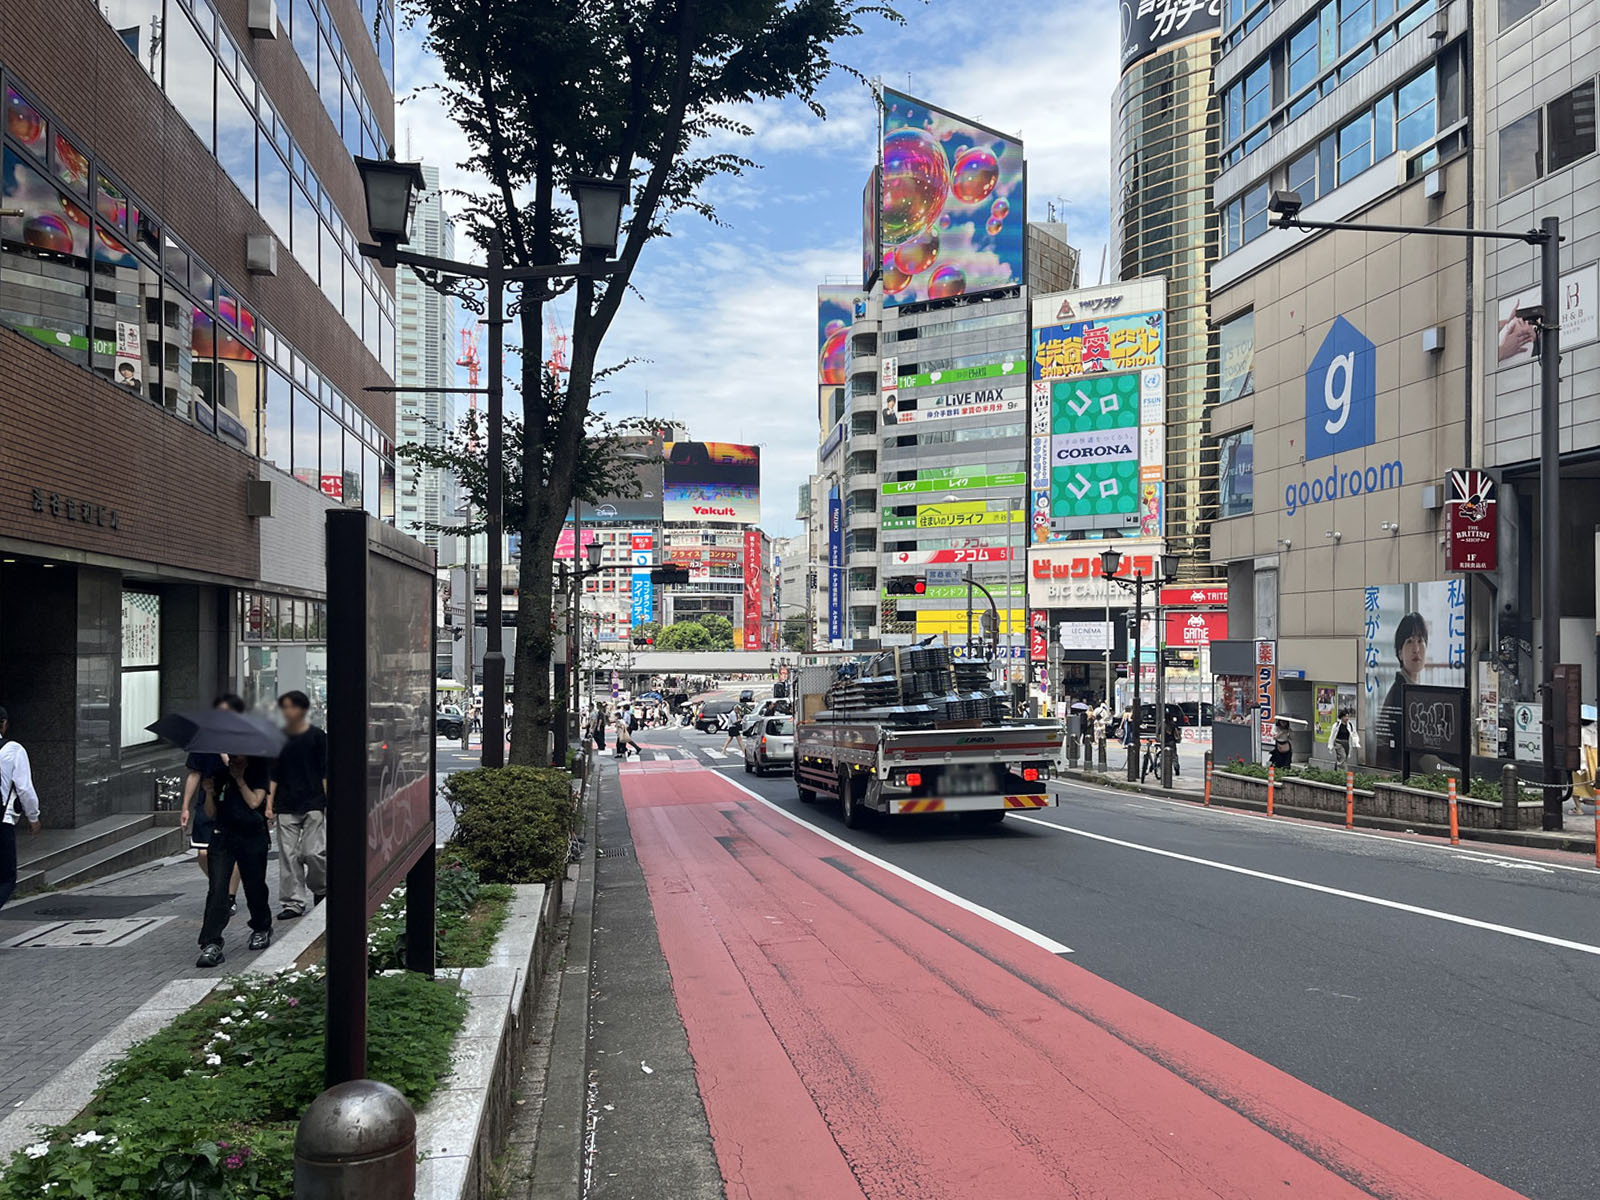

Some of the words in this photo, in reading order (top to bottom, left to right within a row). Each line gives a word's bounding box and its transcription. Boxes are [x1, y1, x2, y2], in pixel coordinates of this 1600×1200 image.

[1091, 362, 1102, 371] AI
[1115, 355, 1156, 369] VISION
[1040, 363, 1084, 377] SHIBUYA
[945, 392, 972, 406] LiVE
[975, 389, 1003, 404] MAX
[1057, 445, 1133, 460] CORONA
[897, 483, 916, 491] レイク
[949, 478, 968, 487] レイク
[1285, 460, 1404, 516] goodroom
[692, 506, 736, 517] Yakult
[920, 514, 984, 528] 住まいのリライフ
[1456, 531, 1490, 539] BRITISH
[954, 549, 989, 562] アコム
[1049, 583, 1071, 599] BIC
[1448, 579, 1465, 669] 私には
[1034, 614, 1045, 654] カオケ
[1184, 628, 1209, 639] GAME
[1364, 586, 1380, 693] 家がない
[1260, 643, 1272, 663] 薬
